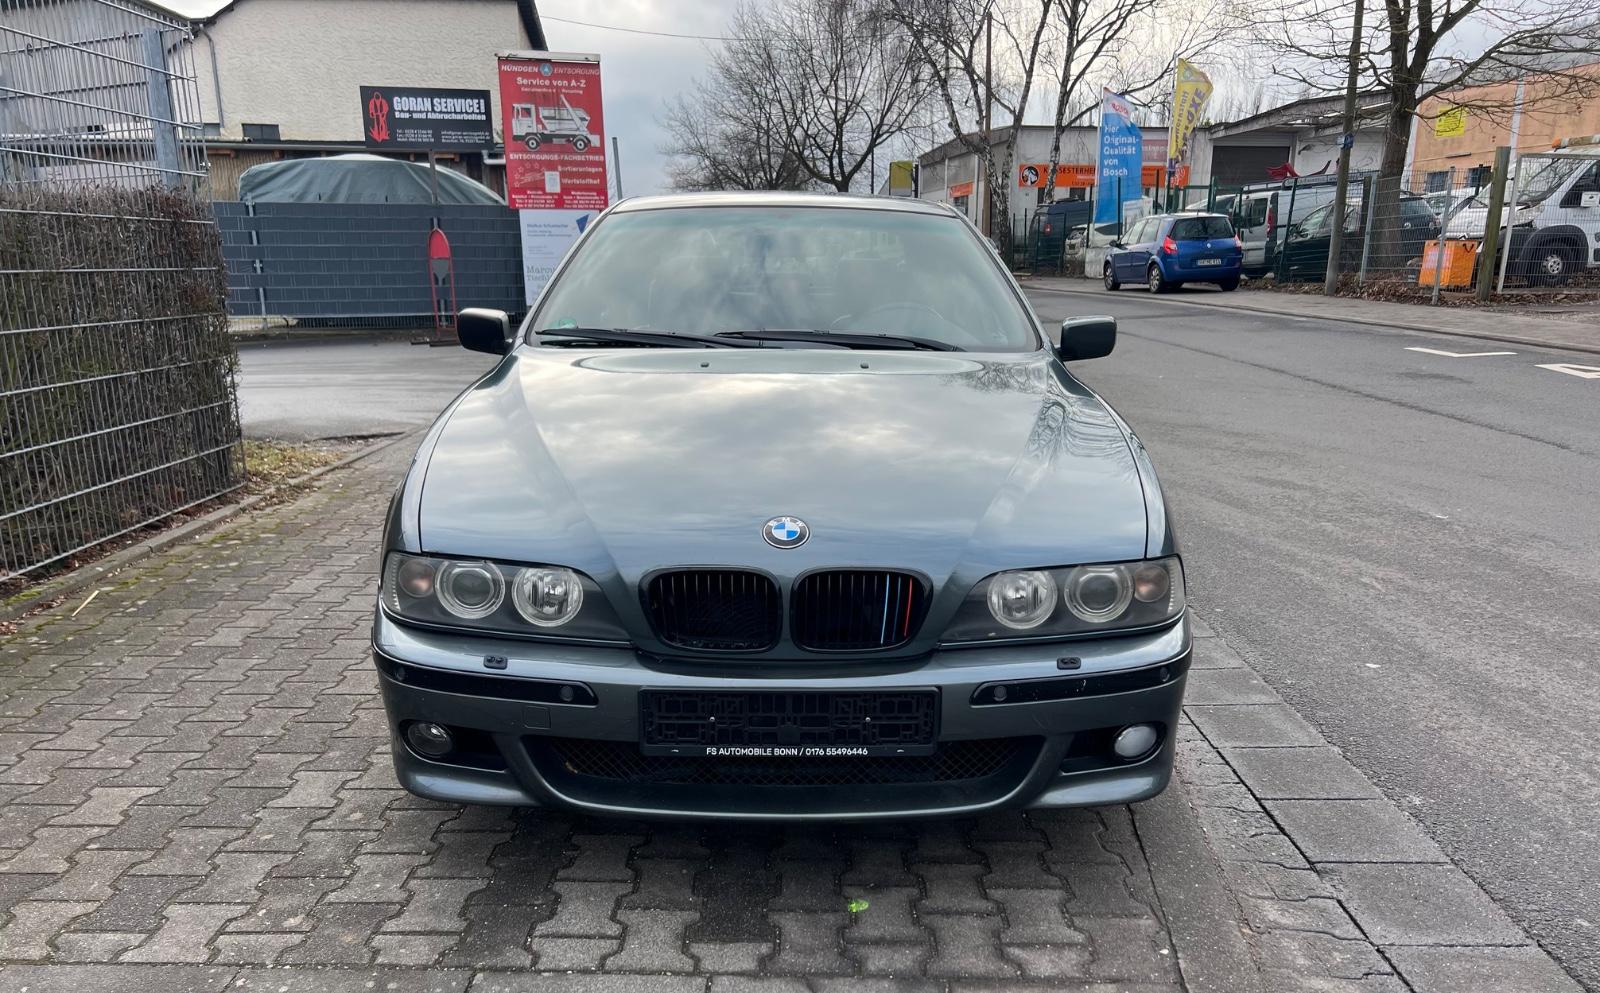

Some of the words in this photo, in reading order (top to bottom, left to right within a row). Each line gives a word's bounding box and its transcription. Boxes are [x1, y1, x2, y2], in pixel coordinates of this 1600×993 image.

[501, 64, 538, 72] HÜNDGEN
[554, 67, 599, 75] ENTSORGUNG
[516, 77, 550, 86] Service
[393, 97, 431, 111] GORAN
[433, 98, 480, 112] SERVICE
[427, 112, 486, 120] Abbrucharbeiten
[1104, 135, 1139, 145] Original-
[1104, 147, 1136, 155] Qualität
[1103, 168, 1127, 176] Bosch
[706, 747, 717, 755] FS
[718, 747, 772, 755] AUTOMOBILE
[799, 747, 804, 756] /
